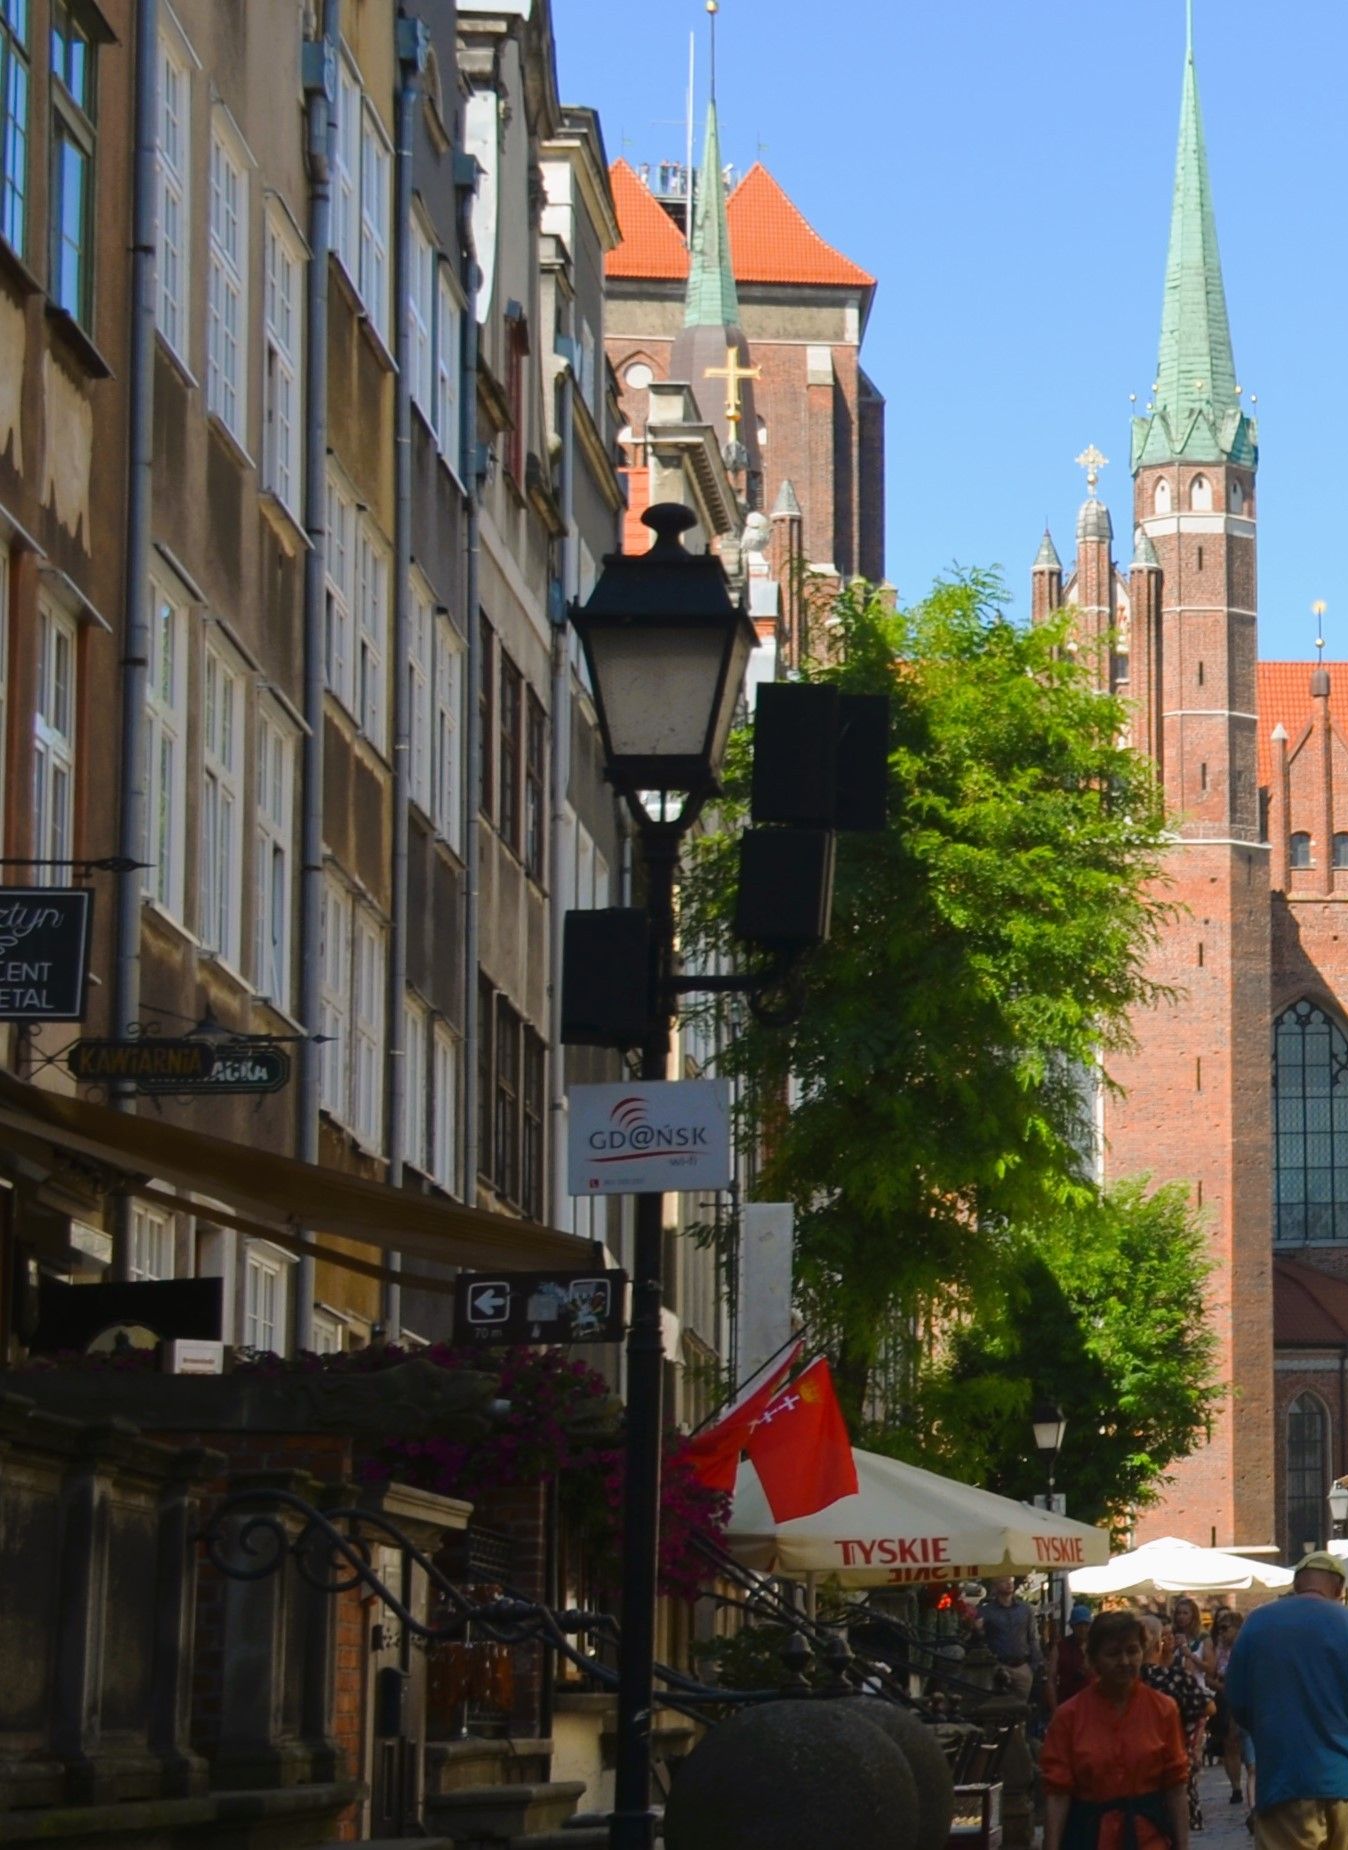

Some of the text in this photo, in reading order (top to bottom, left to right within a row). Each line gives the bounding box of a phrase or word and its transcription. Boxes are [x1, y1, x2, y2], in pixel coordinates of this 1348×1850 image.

[475, 1326, 488, 1339] 70
[834, 1537, 951, 1566] TYSKIE
[1031, 1535, 1084, 1562] TYSKIE
